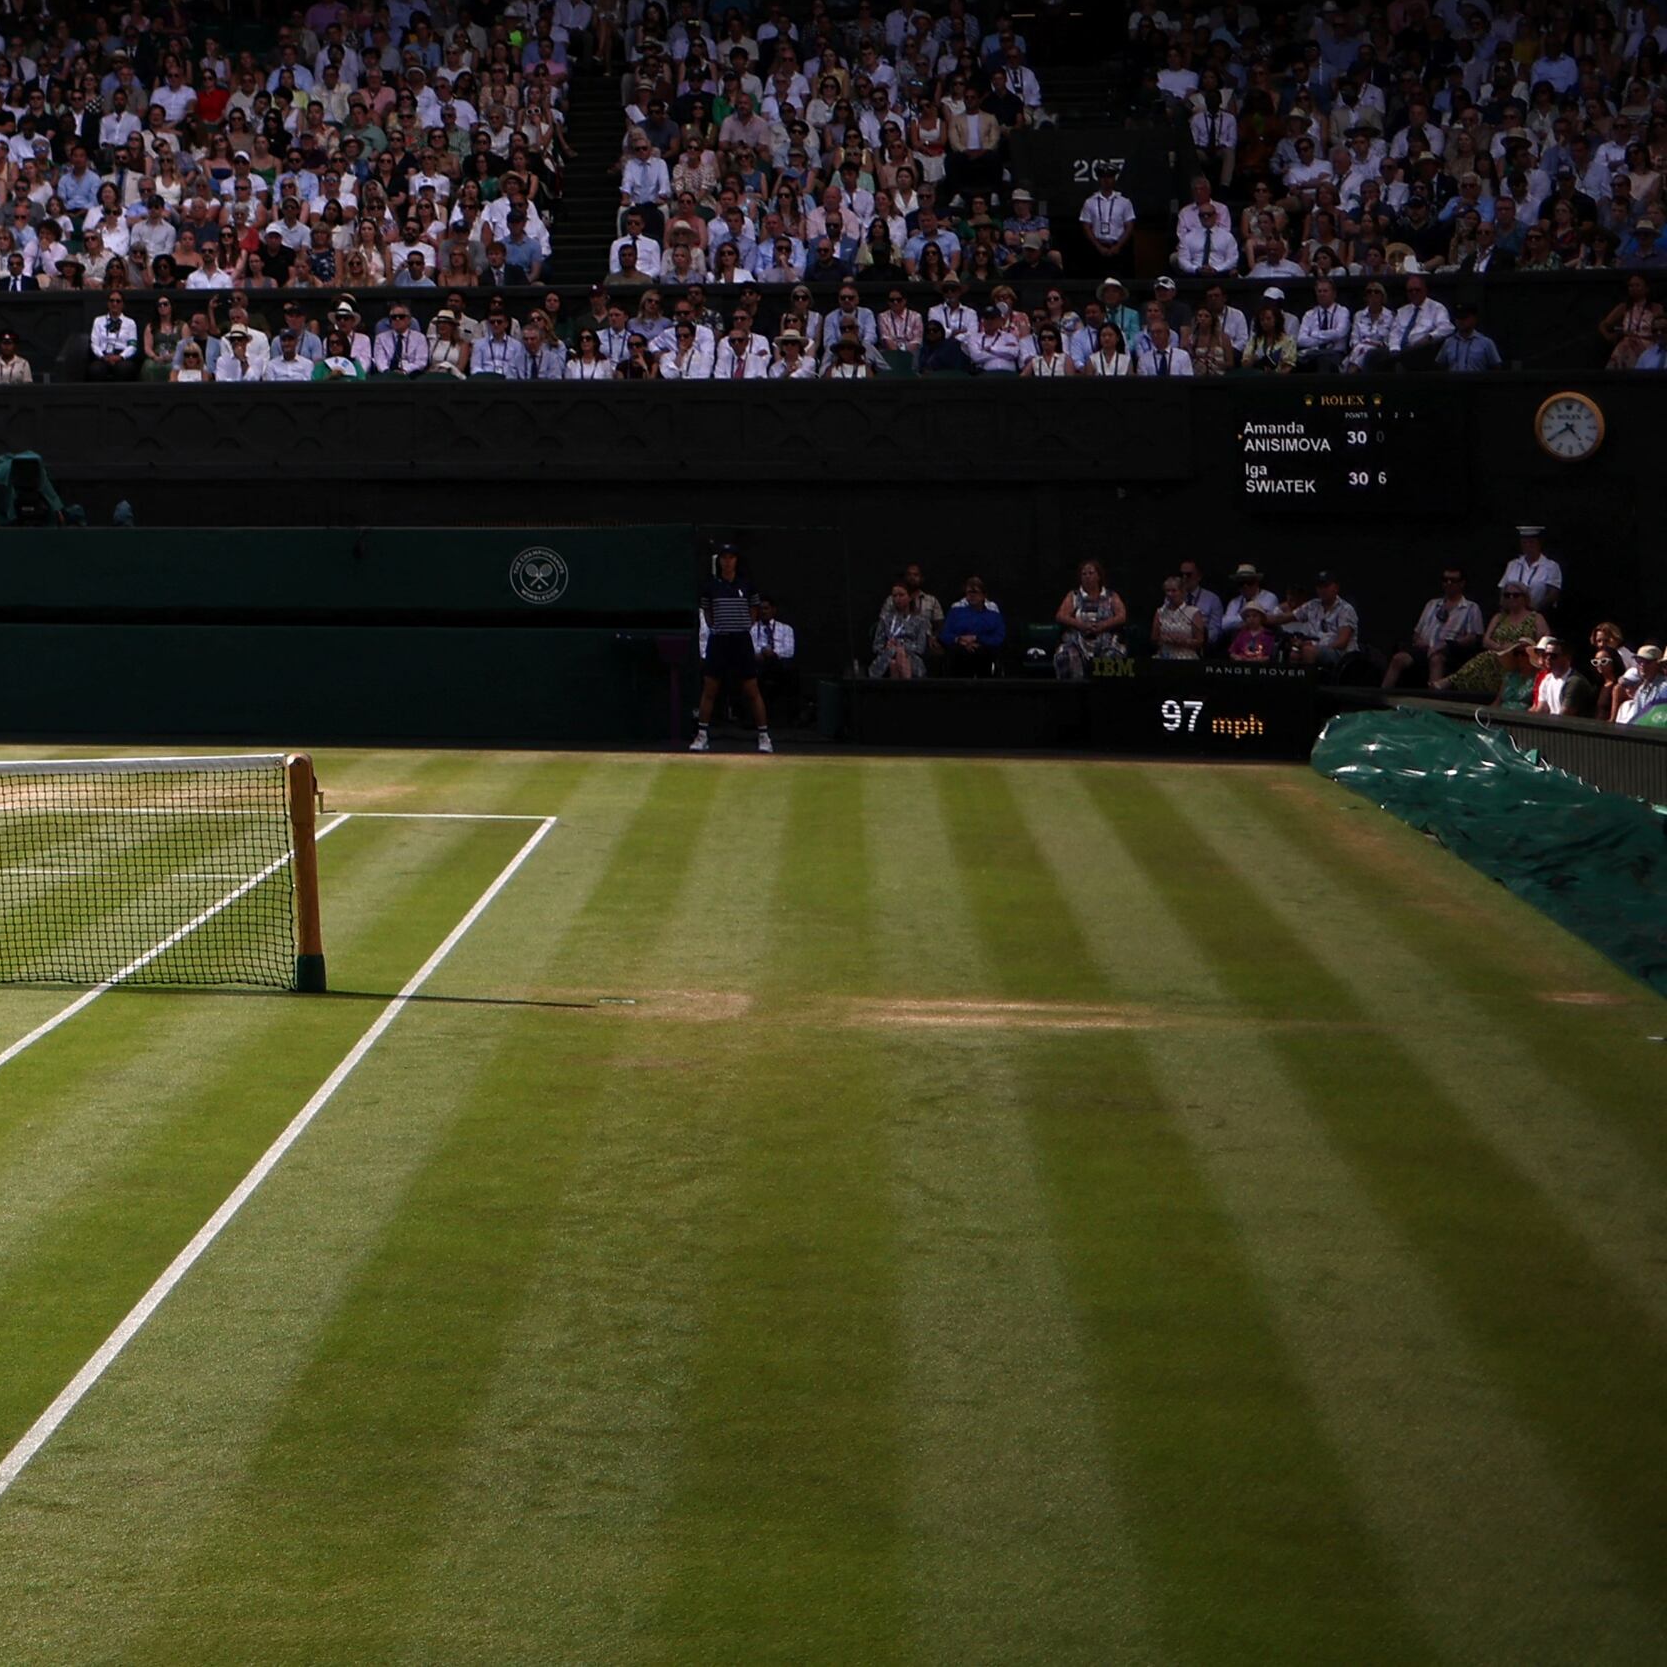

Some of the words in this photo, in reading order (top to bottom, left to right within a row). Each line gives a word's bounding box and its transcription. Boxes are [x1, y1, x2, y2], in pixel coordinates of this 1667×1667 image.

[1320, 395, 1365, 406] ROLEX
[1244, 421, 1305, 435] Amanda
[1347, 431, 1367, 445] 30
[1376, 430, 1385, 444] 0
[1244, 438, 1331, 452] ANISIMOVA
[1245, 463, 1267, 478] Iga
[1348, 472, 1369, 486] 30
[1378, 472, 1387, 485] 6
[1245, 480, 1317, 493] SWIATEK
[1092, 658, 1135, 677] IBM
[1205, 666, 1251, 675] RANGE
[1259, 666, 1306, 677] ROVER
[1161, 700, 1203, 732] 97
[1212, 714, 1264, 739] mph
